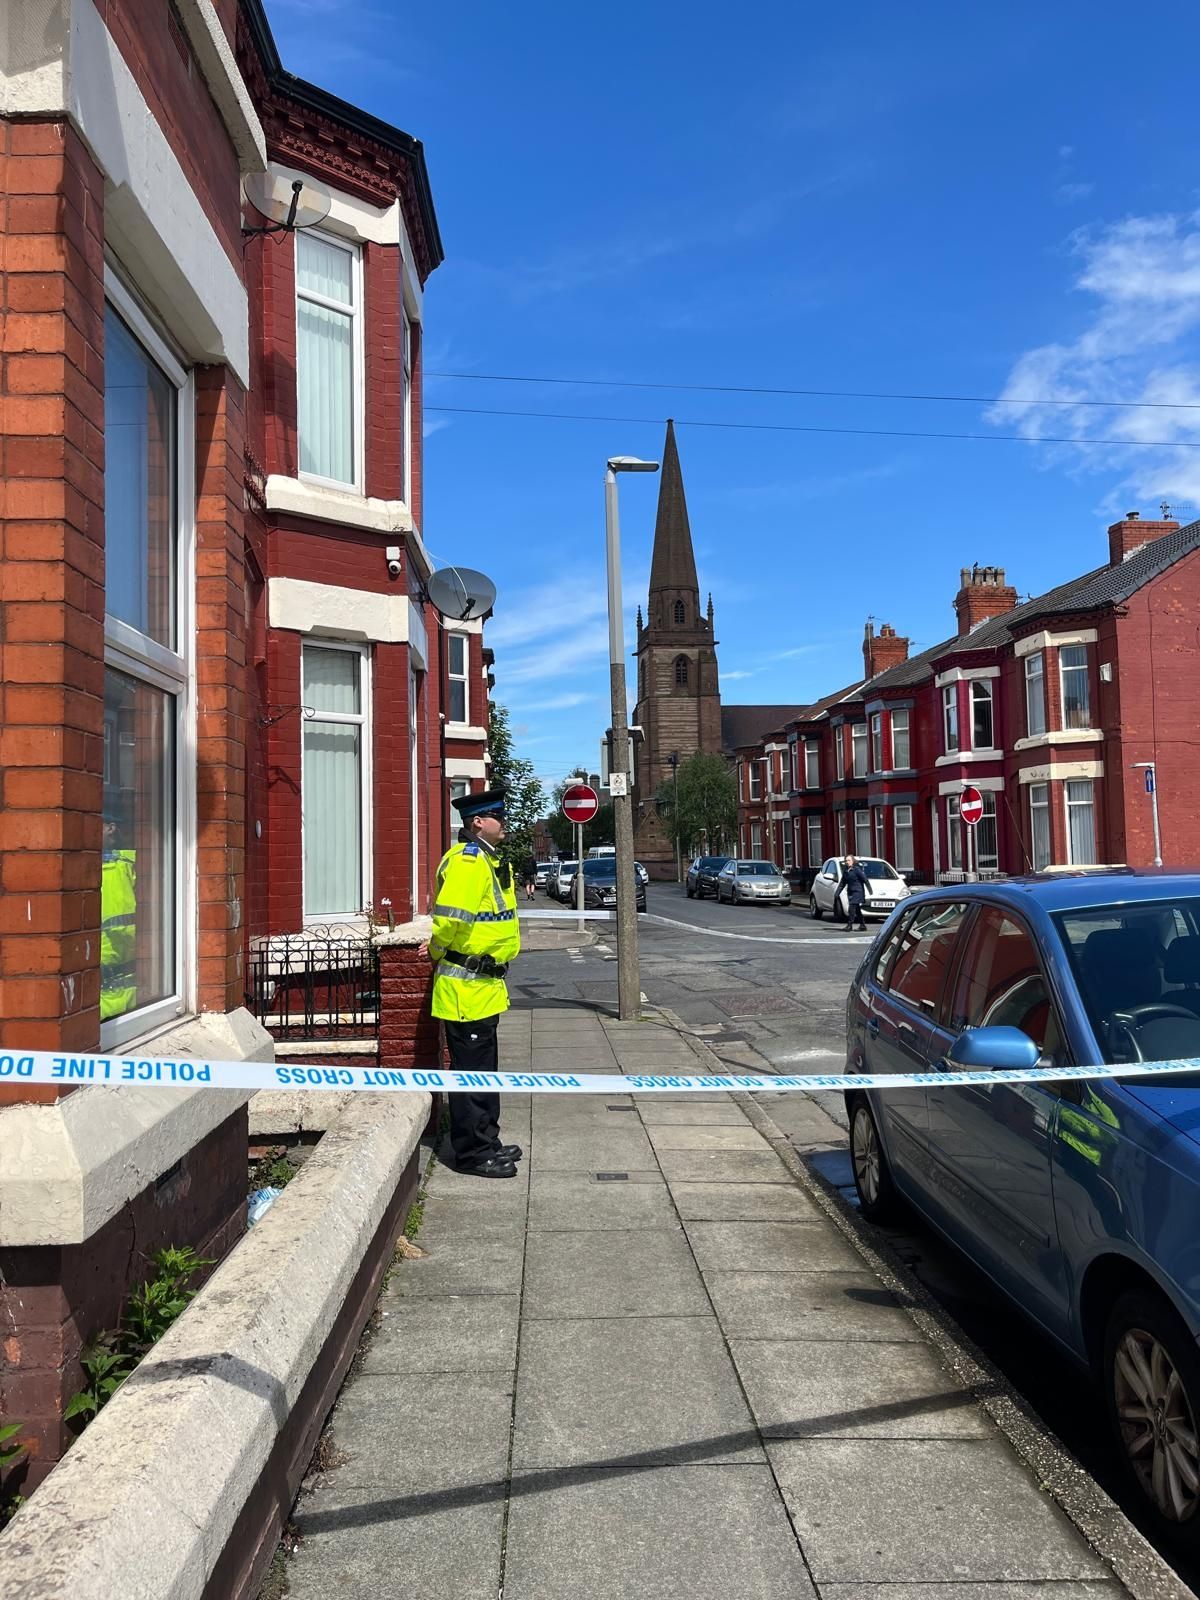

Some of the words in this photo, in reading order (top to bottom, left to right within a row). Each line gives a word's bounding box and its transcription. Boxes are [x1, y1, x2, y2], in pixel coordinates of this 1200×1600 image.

[0, 1056, 35, 1077] DO
[51, 1058, 110, 1079] LINE
[121, 1061, 211, 1082] POLICE
[275, 1067, 354, 1085] CROSS
[363, 1071, 406, 1086] NOT
[412, 1072, 444, 1087] DO
[452, 1073, 503, 1087] LINE
[505, 1074, 581, 1087] POLICE
[625, 1076, 692, 1087] CROSS
[694, 1076, 734, 1087] NOT
[732, 1076, 764, 1087] DO
